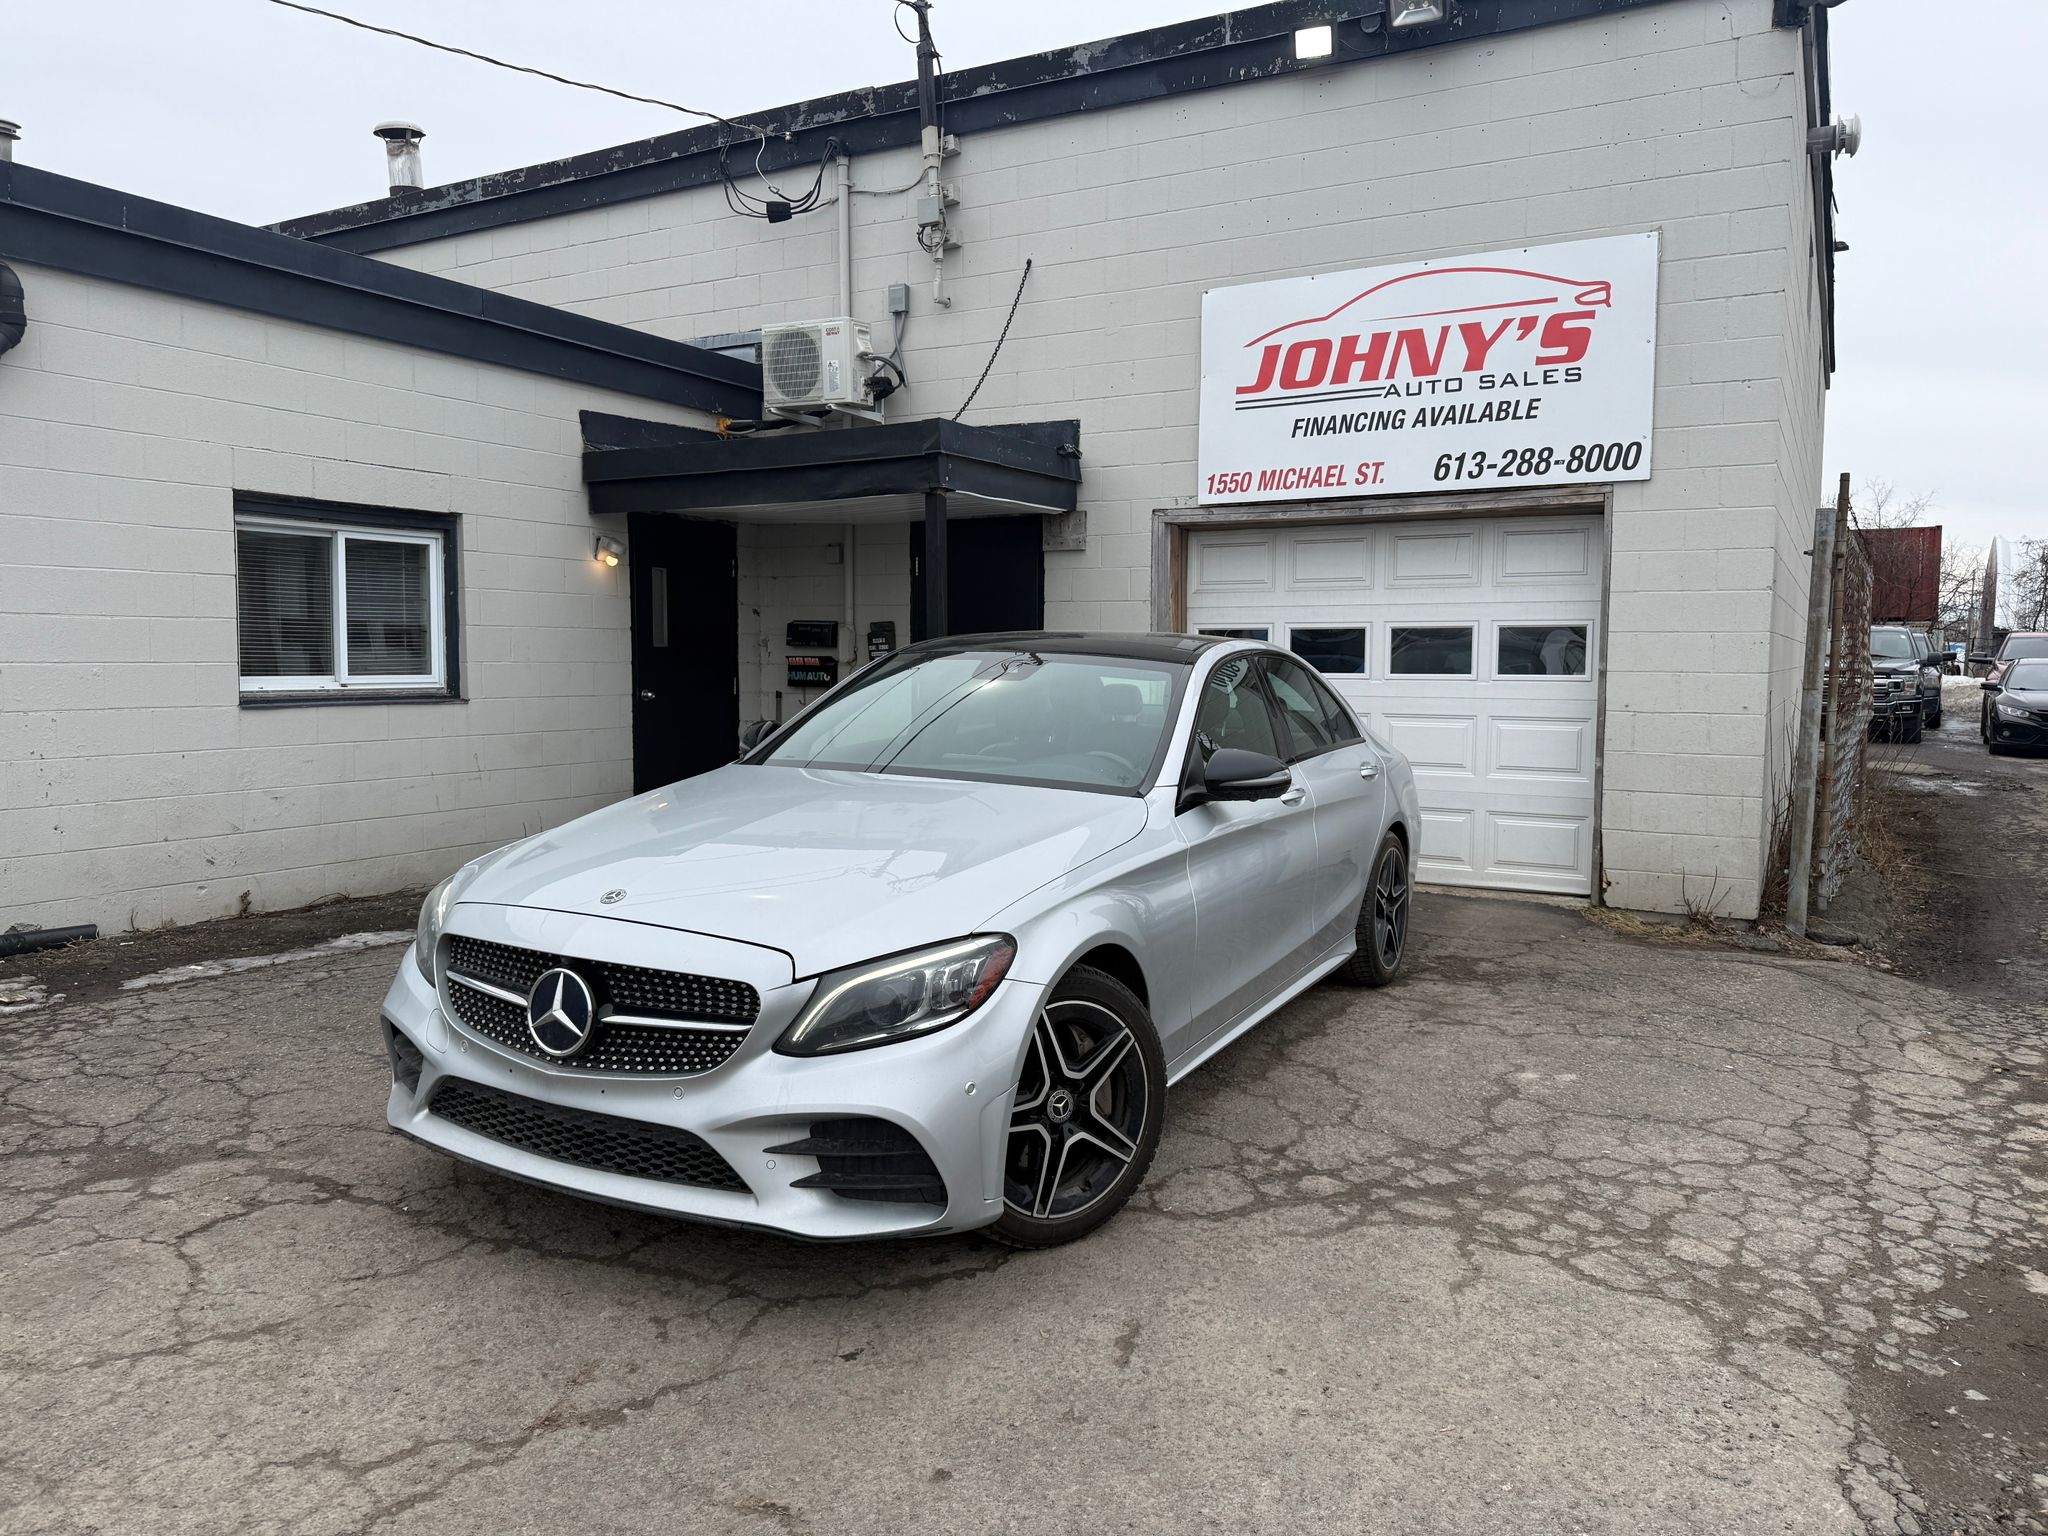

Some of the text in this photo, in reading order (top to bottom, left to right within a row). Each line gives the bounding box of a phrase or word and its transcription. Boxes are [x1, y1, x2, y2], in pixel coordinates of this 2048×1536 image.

[1236, 309, 1597, 395] JOHNY'S
[1384, 366, 1582, 399] AUTO SALES
[1291, 397, 1542, 439] FINANCING AVAILABLE
[1206, 461, 1386, 495] 1550 MICHAEL ST.
[1433, 441, 1643, 482] 613-288-8000
